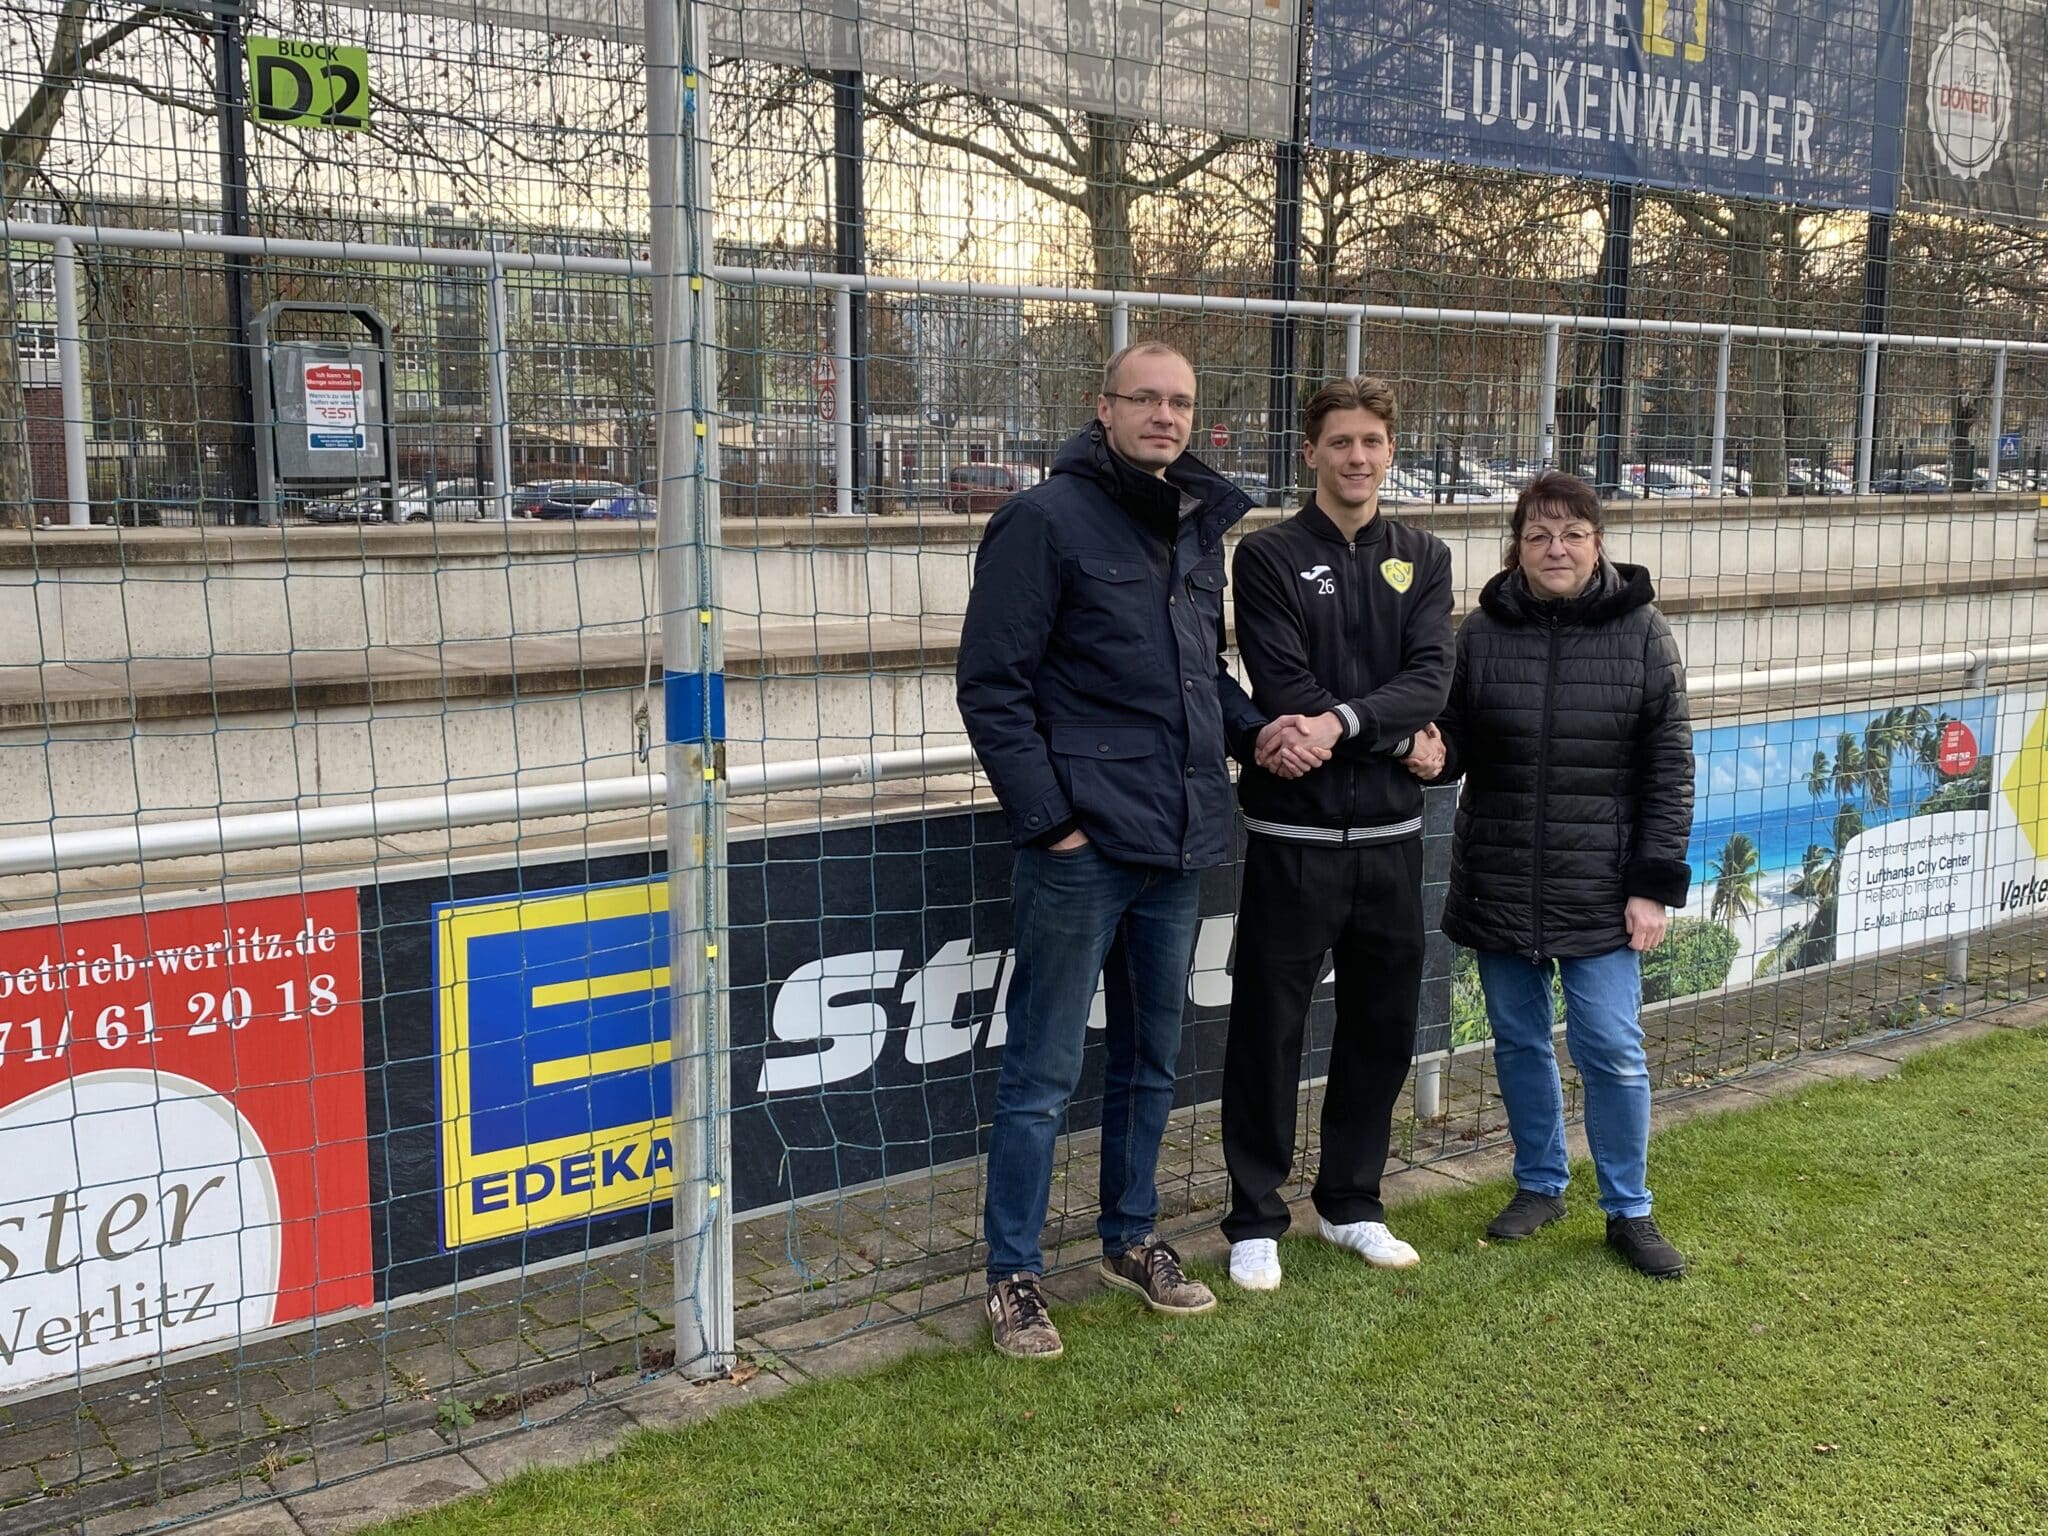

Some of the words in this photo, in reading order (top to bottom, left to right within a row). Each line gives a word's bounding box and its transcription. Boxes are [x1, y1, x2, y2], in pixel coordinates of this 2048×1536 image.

[278, 40, 339, 62] BLOCK
[257, 55, 362, 127] D2
[1441, 38, 1815, 169] LUCKENWALDER
[1940, 81, 1990, 115] DÖNER
[1317, 578, 1335, 595] 26
[1866, 866, 1915, 885] Lufthansa
[1916, 860, 1937, 875] City
[1938, 854, 1971, 870] Center
[95, 1001, 163, 1050] 61
[187, 986, 251, 1037] 20
[275, 973, 338, 1023] 18
[471, 1137, 673, 1216] EDEKA
